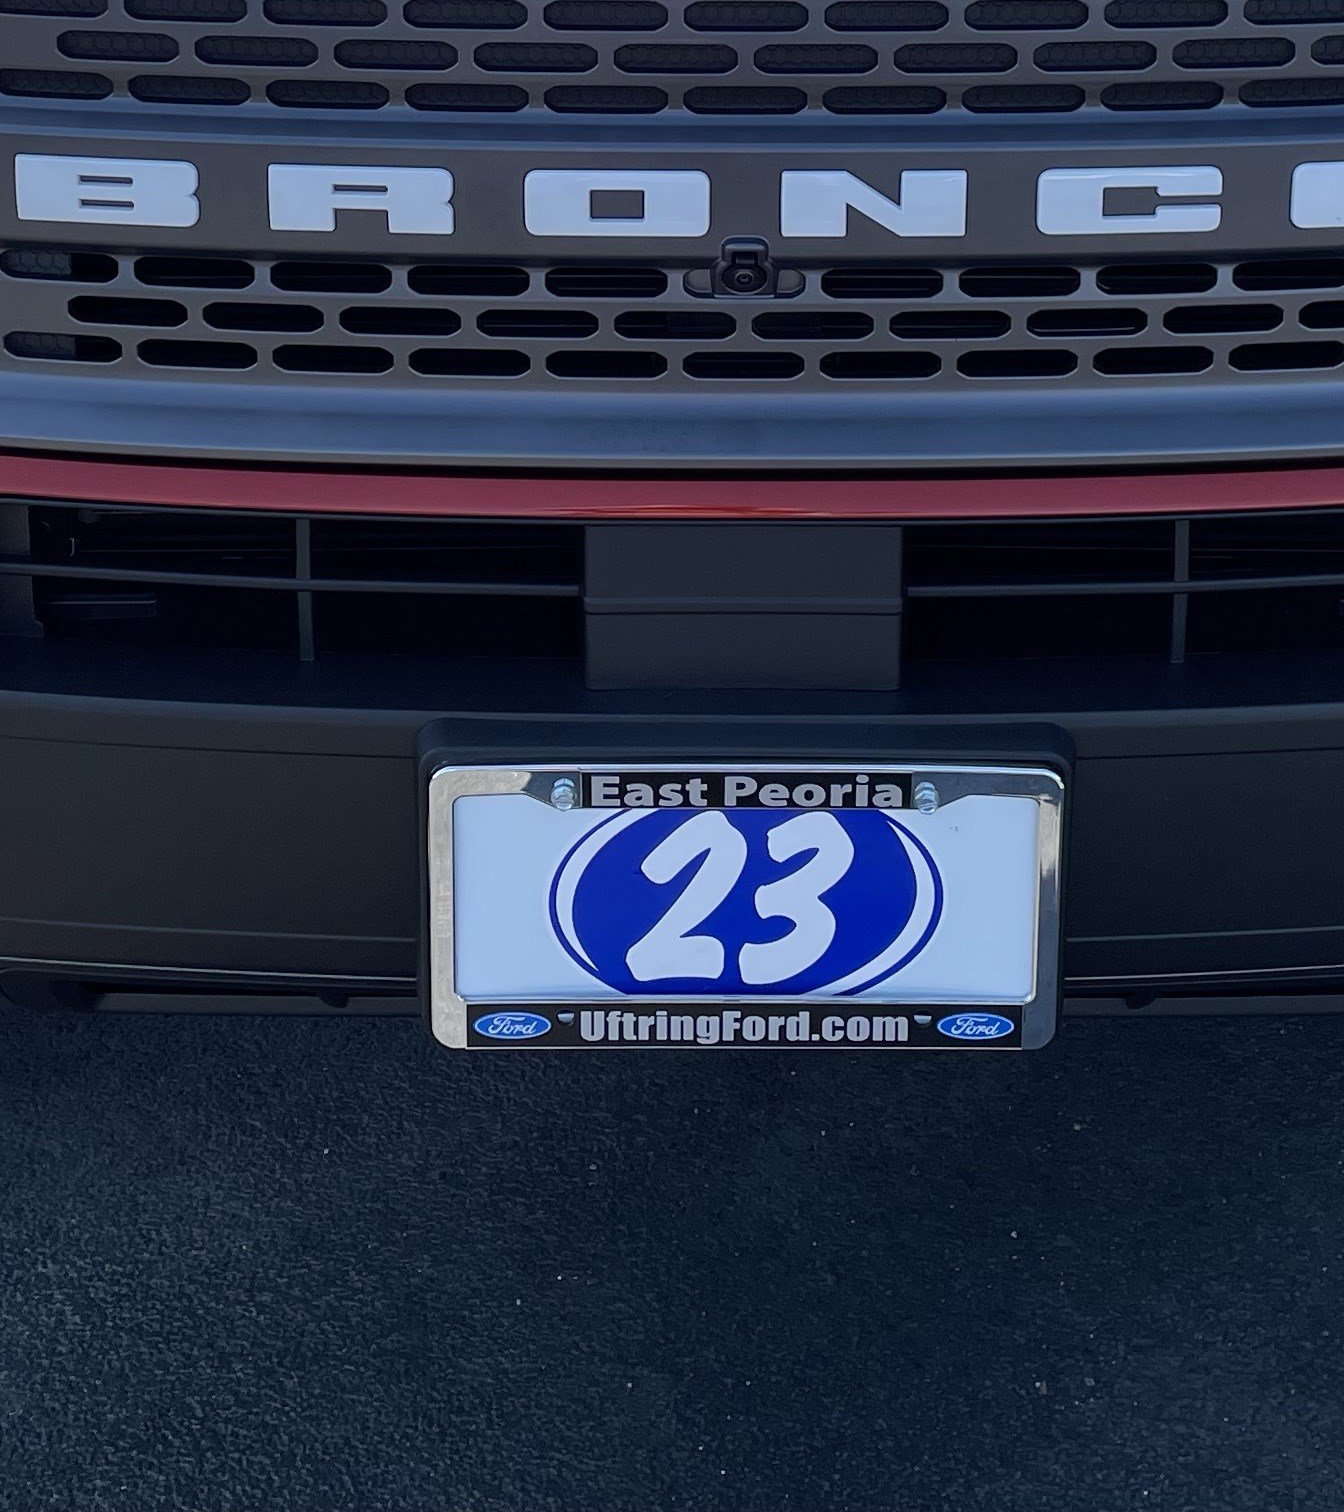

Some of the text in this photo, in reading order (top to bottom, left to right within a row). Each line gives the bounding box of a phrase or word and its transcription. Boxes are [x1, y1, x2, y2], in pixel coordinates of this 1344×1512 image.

[590, 774, 904, 808] East Peoria
[625, 809, 855, 985] 23
[487, 1016, 538, 1035] Ford
[579, 1010, 908, 1045] UftringFord.com
[951, 1017, 1001, 1036] Ford
